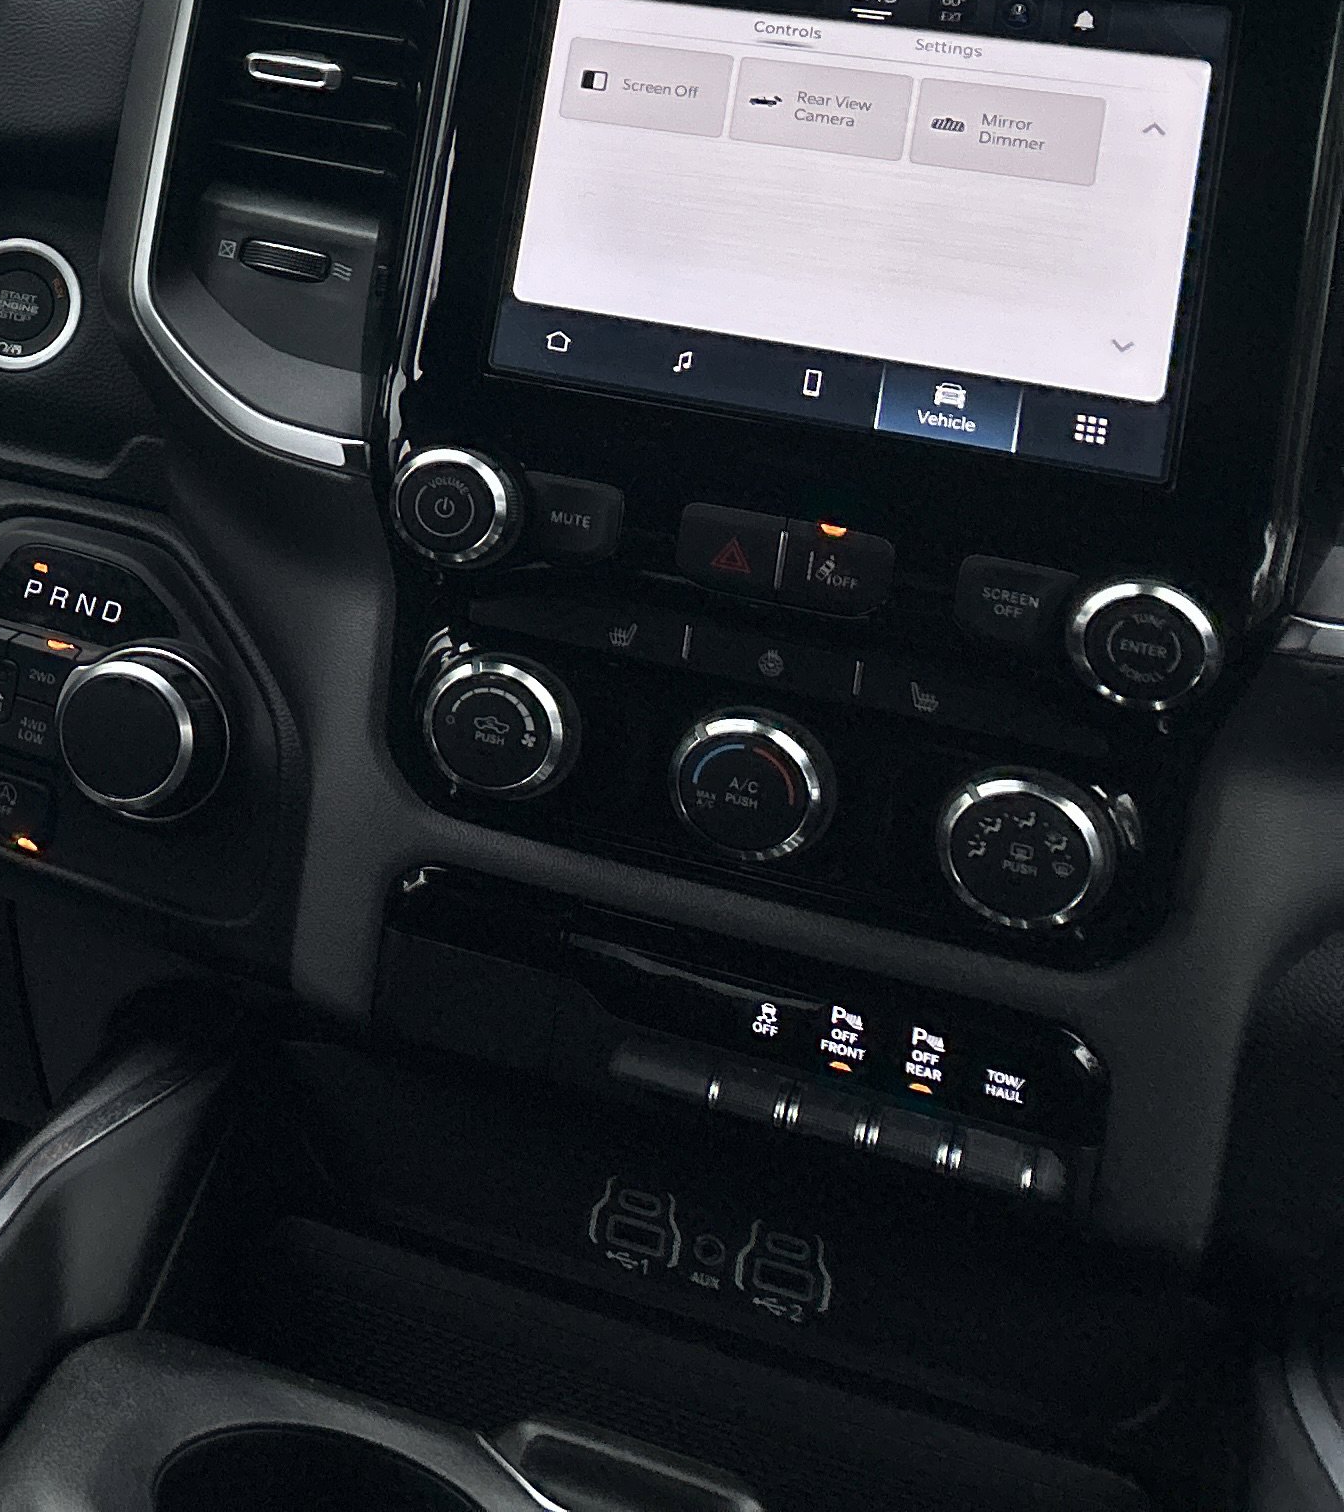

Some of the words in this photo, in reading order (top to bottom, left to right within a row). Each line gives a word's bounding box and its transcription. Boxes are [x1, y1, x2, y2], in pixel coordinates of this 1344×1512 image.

[753, 19, 823, 40] Controls
[915, 38, 983, 60] Settings
[622, 78, 672, 96] Screen
[674, 83, 700, 99] Off
[796, 90, 832, 108] Rear
[835, 95, 873, 112] View
[793, 108, 855, 128] Camera
[981, 112, 1034, 132] Mirror
[977, 130, 1046, 152] Dimmer
[0, 288, 39, 303] START
[0, 309, 33, 323] STOP
[917, 408, 977, 433] Vehicle
[427, 475, 471, 497] VOLUME
[549, 509, 592, 531] MUTE
[827, 572, 859, 590] OFF
[980, 586, 1040, 610] SCREEN
[992, 603, 1024, 619] OFF
[1118, 637, 1169, 660] ENTER
[27, 667, 57, 686] 2WD
[18, 715, 48, 733] 4WD
[16, 728, 45, 746] LOW
[473, 729, 506, 747] PUSH
[728, 775, 760, 795] A/C
[724, 791, 759, 810] PUSH
[1002, 858, 1039, 878] PUSH
[752, 1020, 779, 1037] OFF
[830, 1027, 859, 1045] OFF
[819, 1037, 867, 1062] FRONT
[911, 1049, 941, 1066] OFF
[904, 1060, 943, 1083] REAR
[984, 1082, 1025, 1105] HAUL
[688, 1270, 721, 1291] AUX
